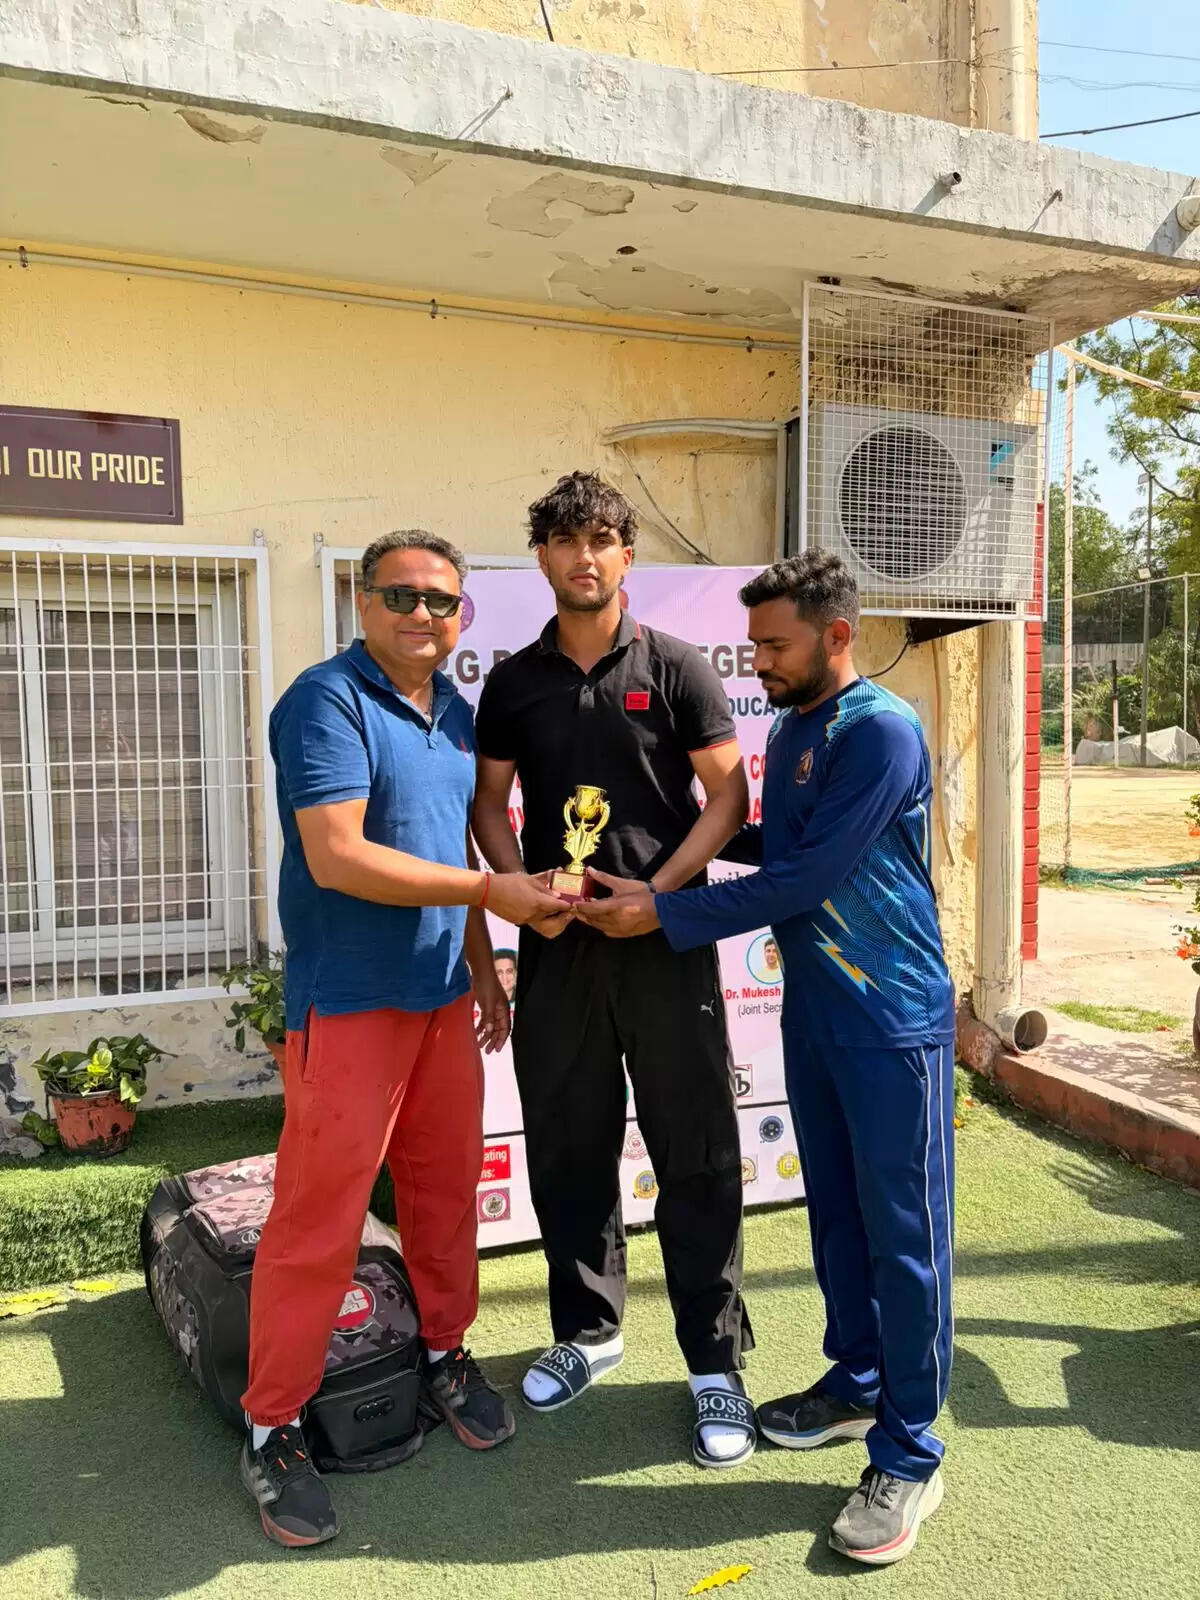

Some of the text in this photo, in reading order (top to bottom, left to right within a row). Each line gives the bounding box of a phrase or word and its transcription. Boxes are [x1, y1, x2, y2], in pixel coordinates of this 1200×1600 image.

[27, 447, 83, 480] OUR
[90, 452, 165, 485] PRIDE
[697, 645, 755, 678] GE
[725, 986, 781, 1000] Dr. Mukesh
[737, 1004, 761, 1018] (Joint
[698, 1395, 747, 1416] BOSS
